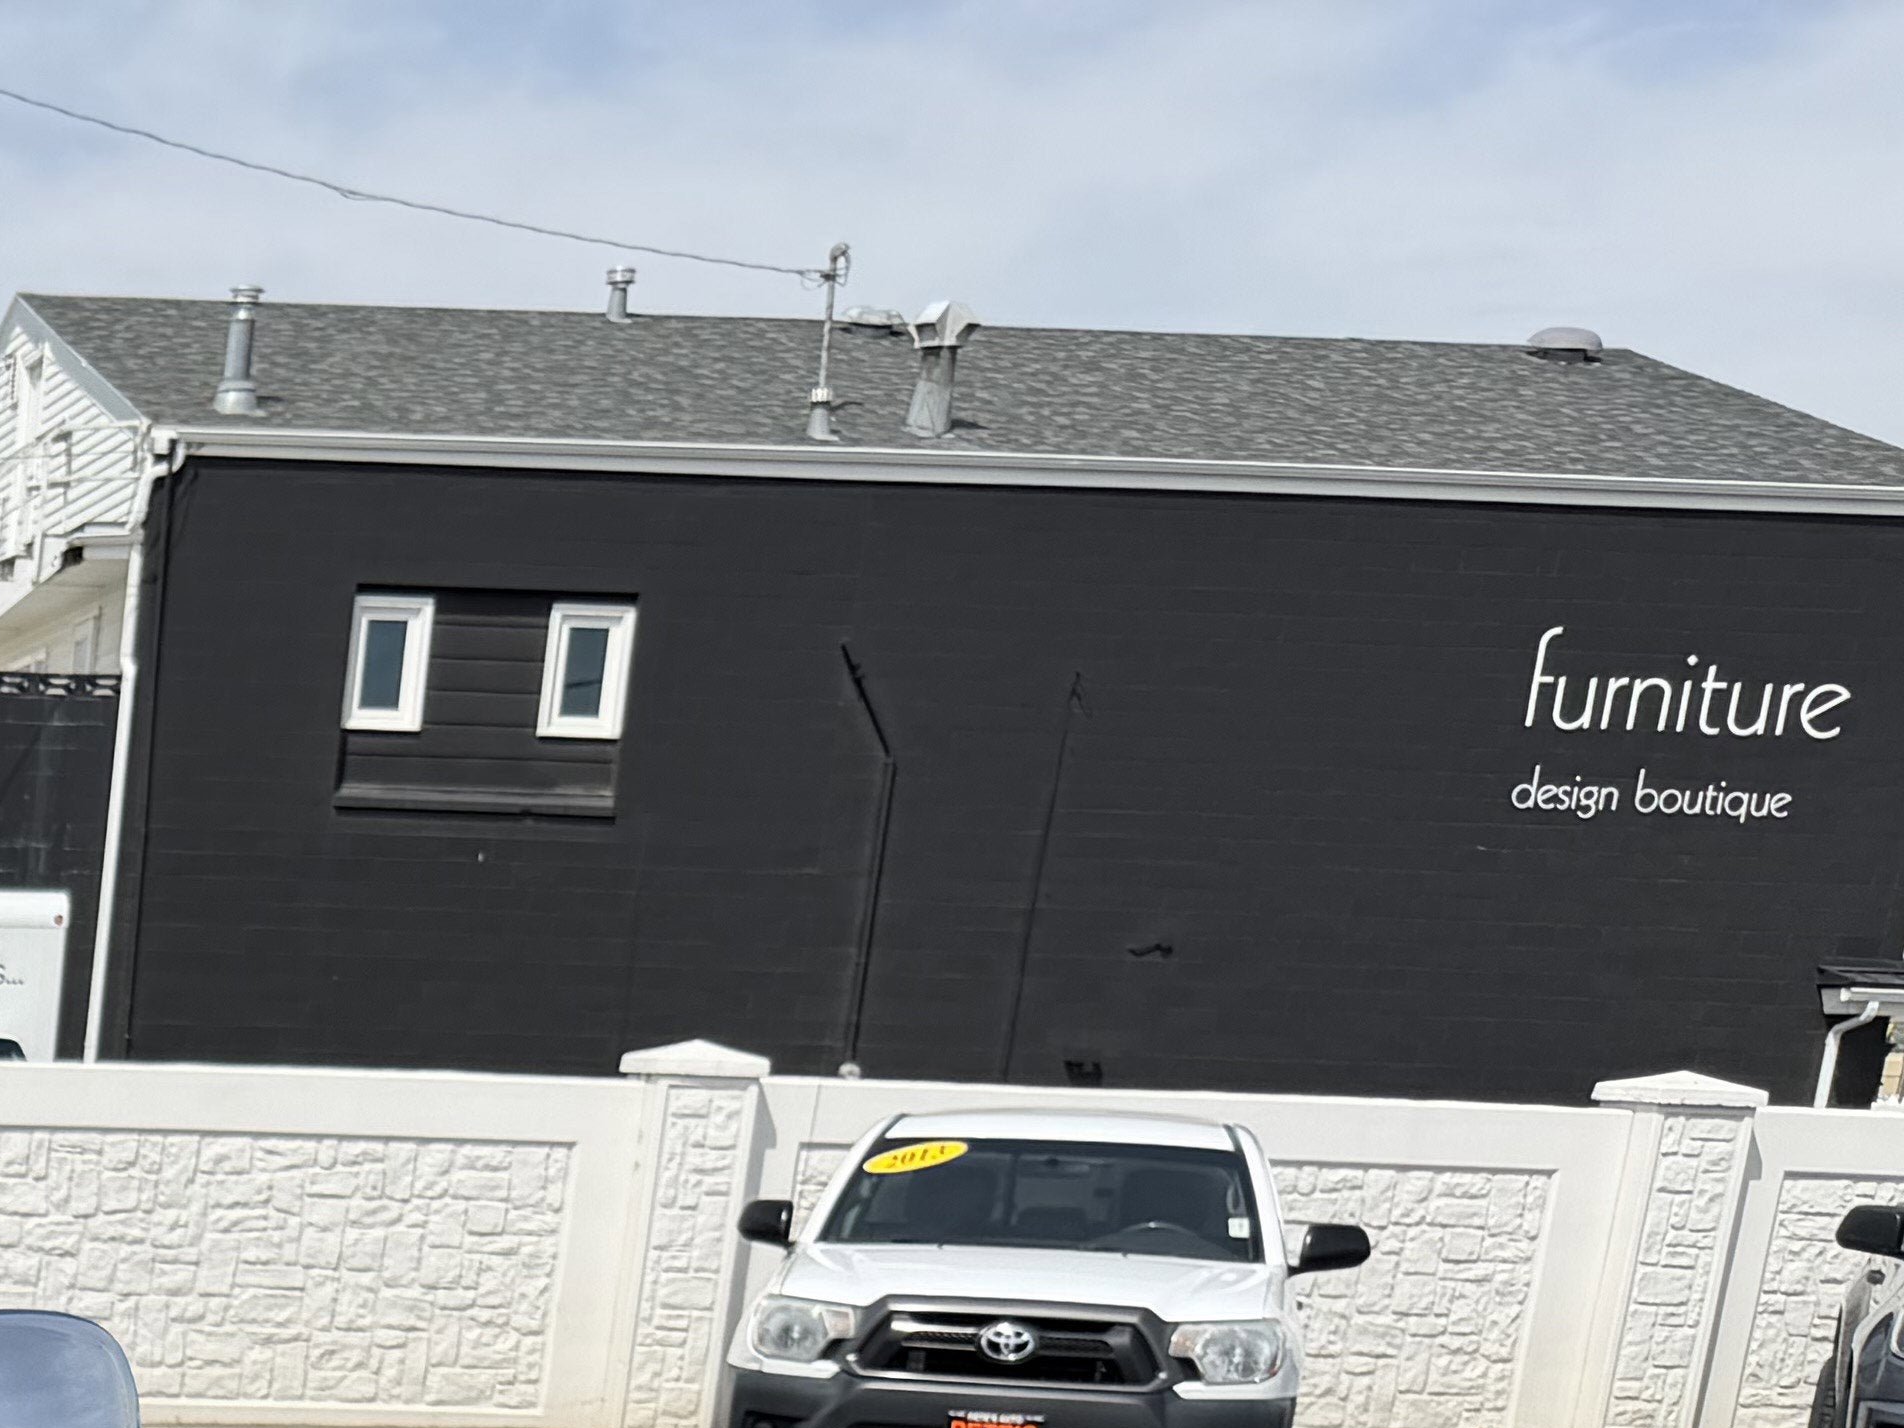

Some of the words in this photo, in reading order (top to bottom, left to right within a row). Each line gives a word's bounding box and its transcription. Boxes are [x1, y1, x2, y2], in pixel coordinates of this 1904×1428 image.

[1524, 625, 1852, 740] furniture
[1510, 764, 1620, 819] design
[1633, 767, 1794, 824] boutique
